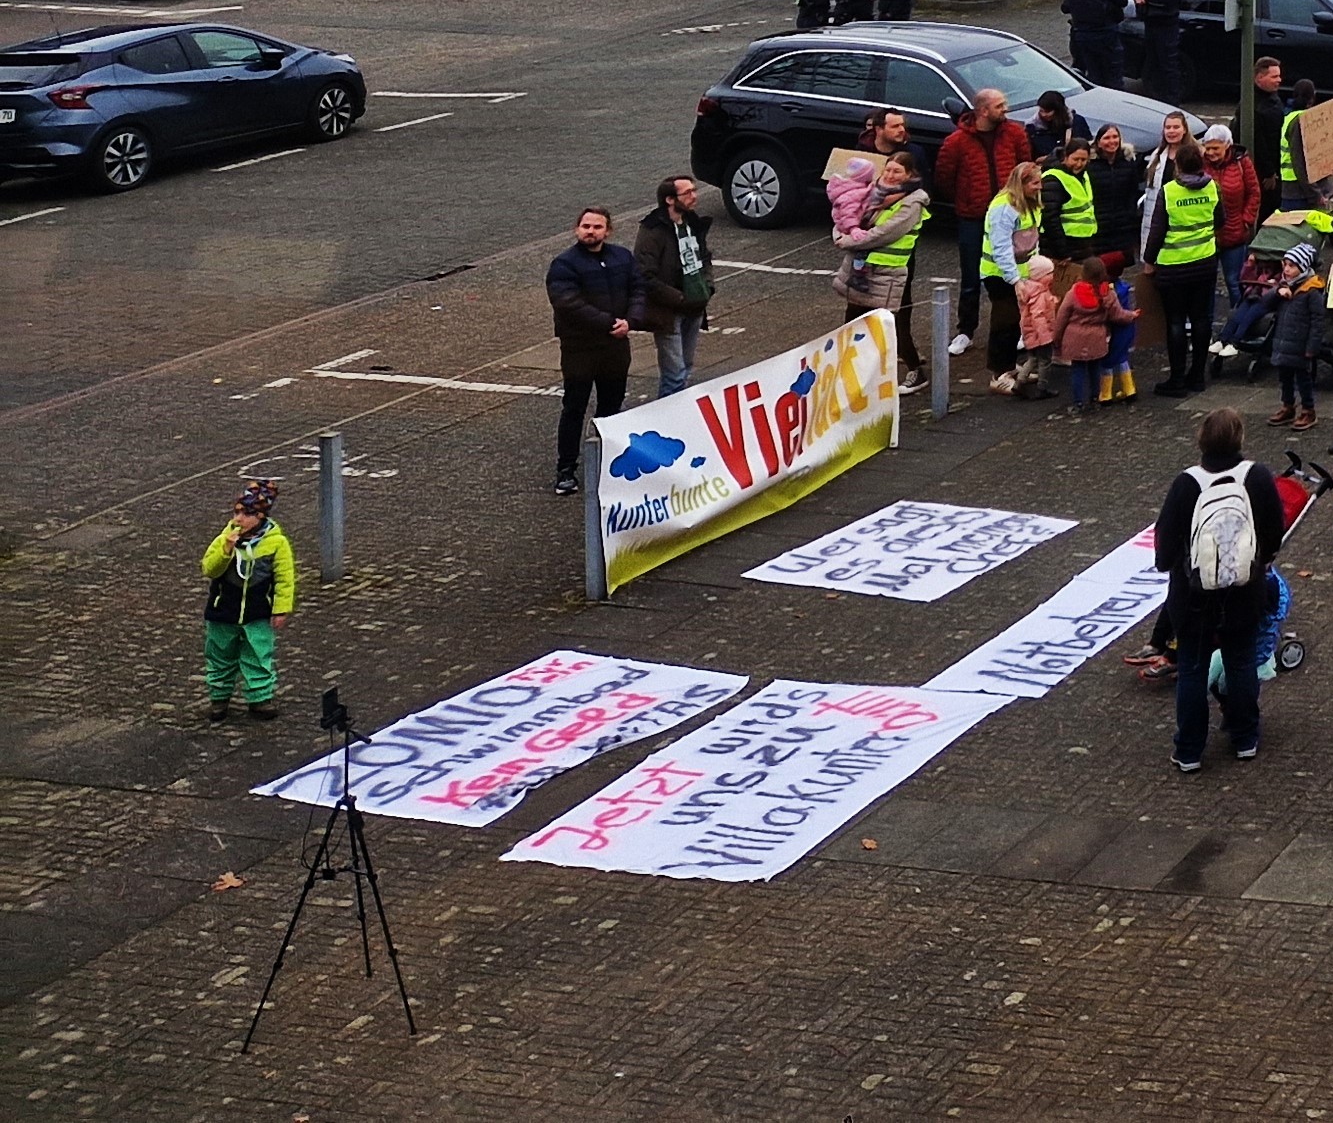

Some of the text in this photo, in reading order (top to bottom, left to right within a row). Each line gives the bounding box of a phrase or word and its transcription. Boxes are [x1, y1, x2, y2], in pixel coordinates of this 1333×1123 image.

[769, 504, 940, 573] Wer sagt
[825, 557, 881, 581] es
[368, 665, 651, 807] Schwimmbad
[418, 692, 658, 808] Kein Geld
[659, 724, 838, 826] uns zu
[532, 760, 705, 851] Jetzt
